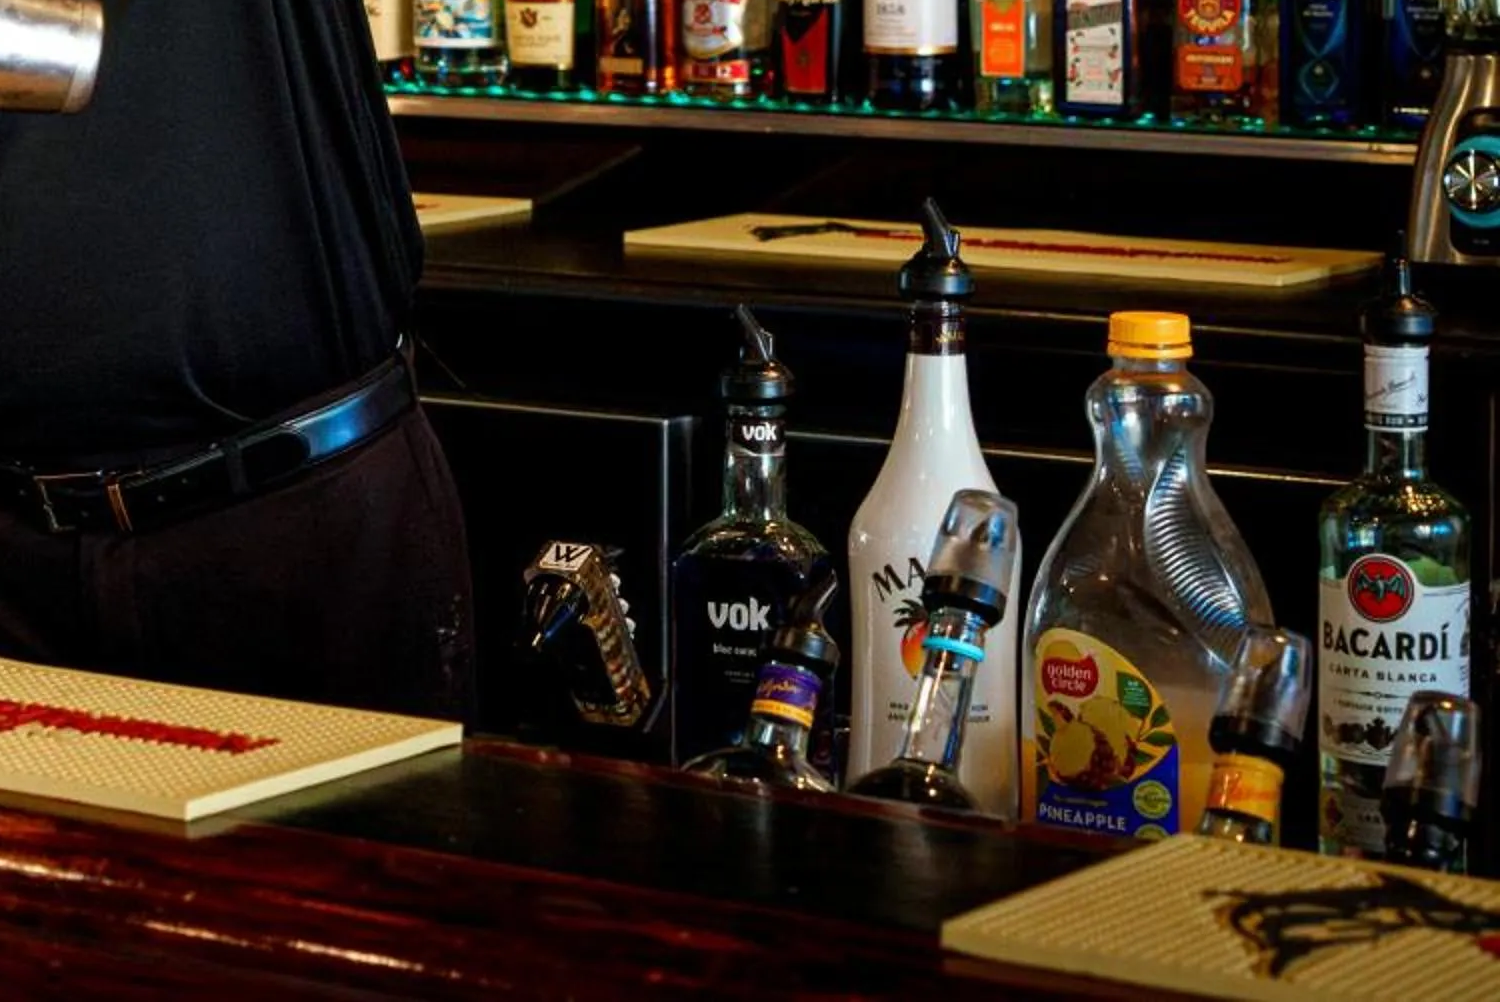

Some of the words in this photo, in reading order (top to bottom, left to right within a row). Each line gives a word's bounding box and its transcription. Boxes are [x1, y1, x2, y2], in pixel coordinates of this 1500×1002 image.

[741, 421, 778, 441] vok
[706, 596, 772, 631] vok
[1322, 621, 1451, 662] BACARDÍ
[1046, 661, 1093, 682] golden
[1328, 661, 1370, 680] CARTA
[1375, 672, 1438, 684] BLANCA
[1051, 677, 1088, 693] circle
[1038, 801, 1128, 832] PINEAPPLE
